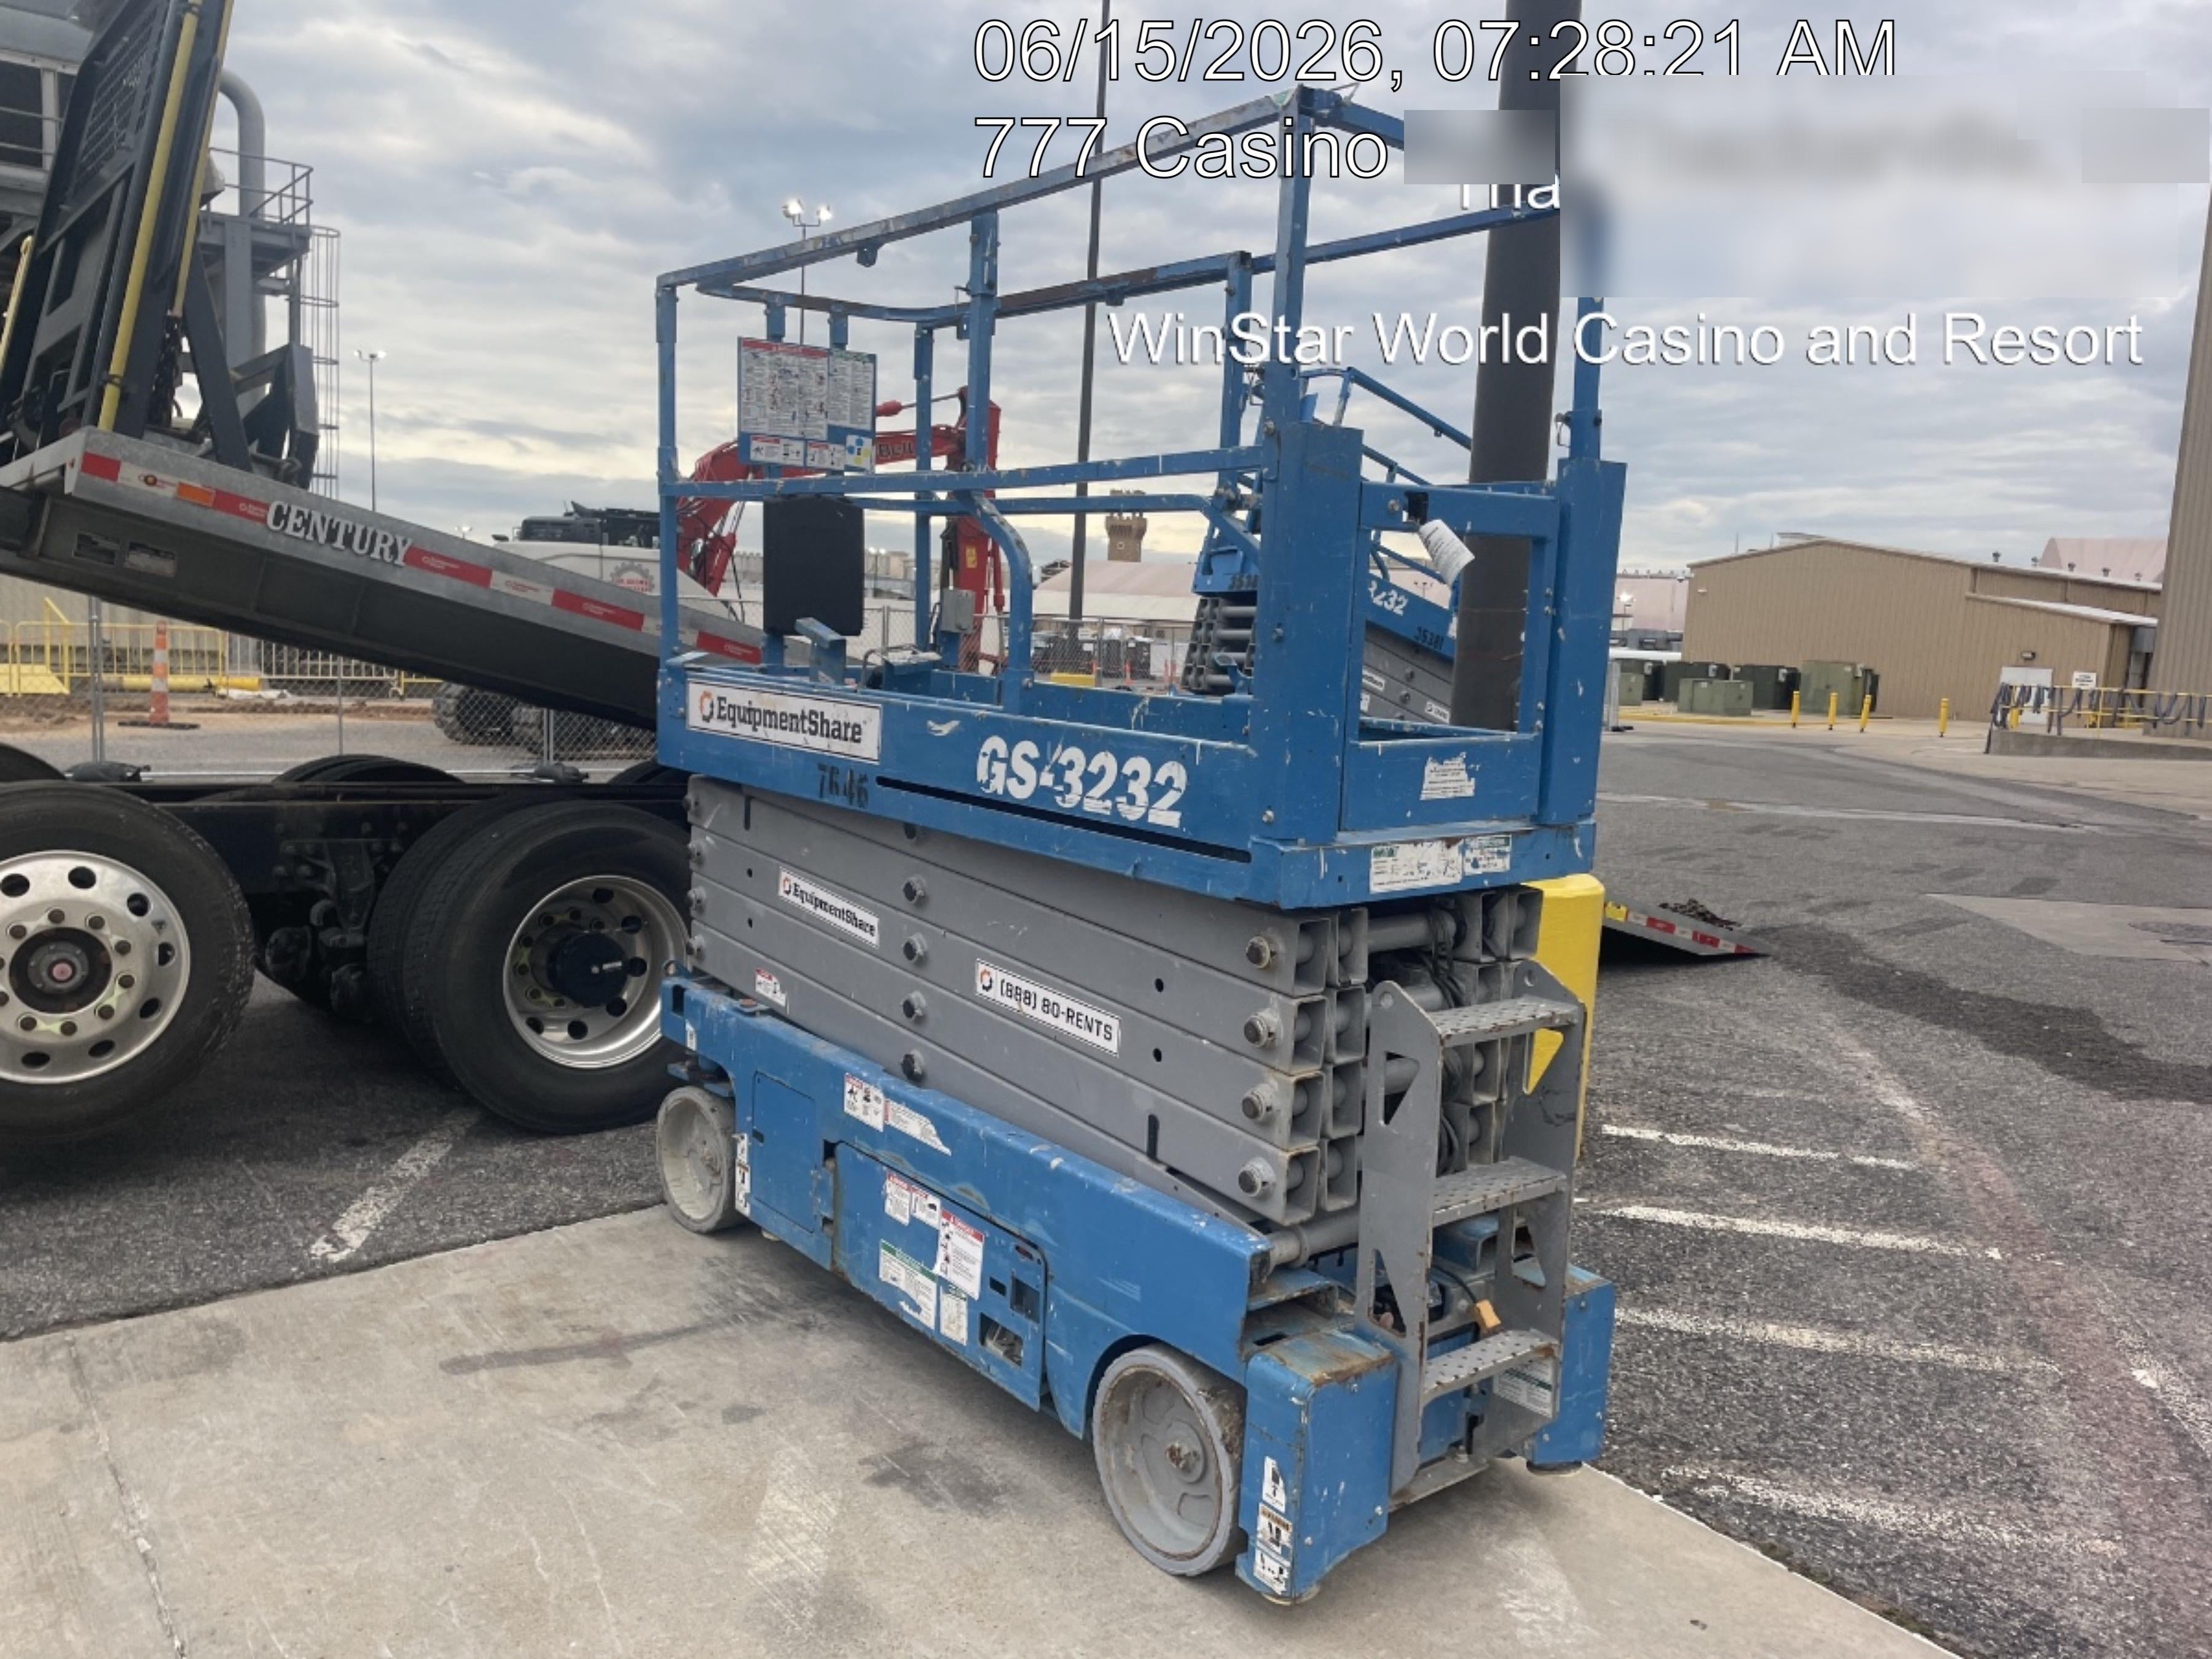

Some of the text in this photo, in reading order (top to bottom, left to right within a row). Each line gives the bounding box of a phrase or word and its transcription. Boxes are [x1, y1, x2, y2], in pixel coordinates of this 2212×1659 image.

[267, 501, 416, 567] CENTURY
[716, 696, 862, 743] EquipmentShare
[976, 735, 1188, 829] GS-3232
[793, 882, 876, 937] EquipmentShare
[1041, 997, 1112, 1041] 80-RENTS
